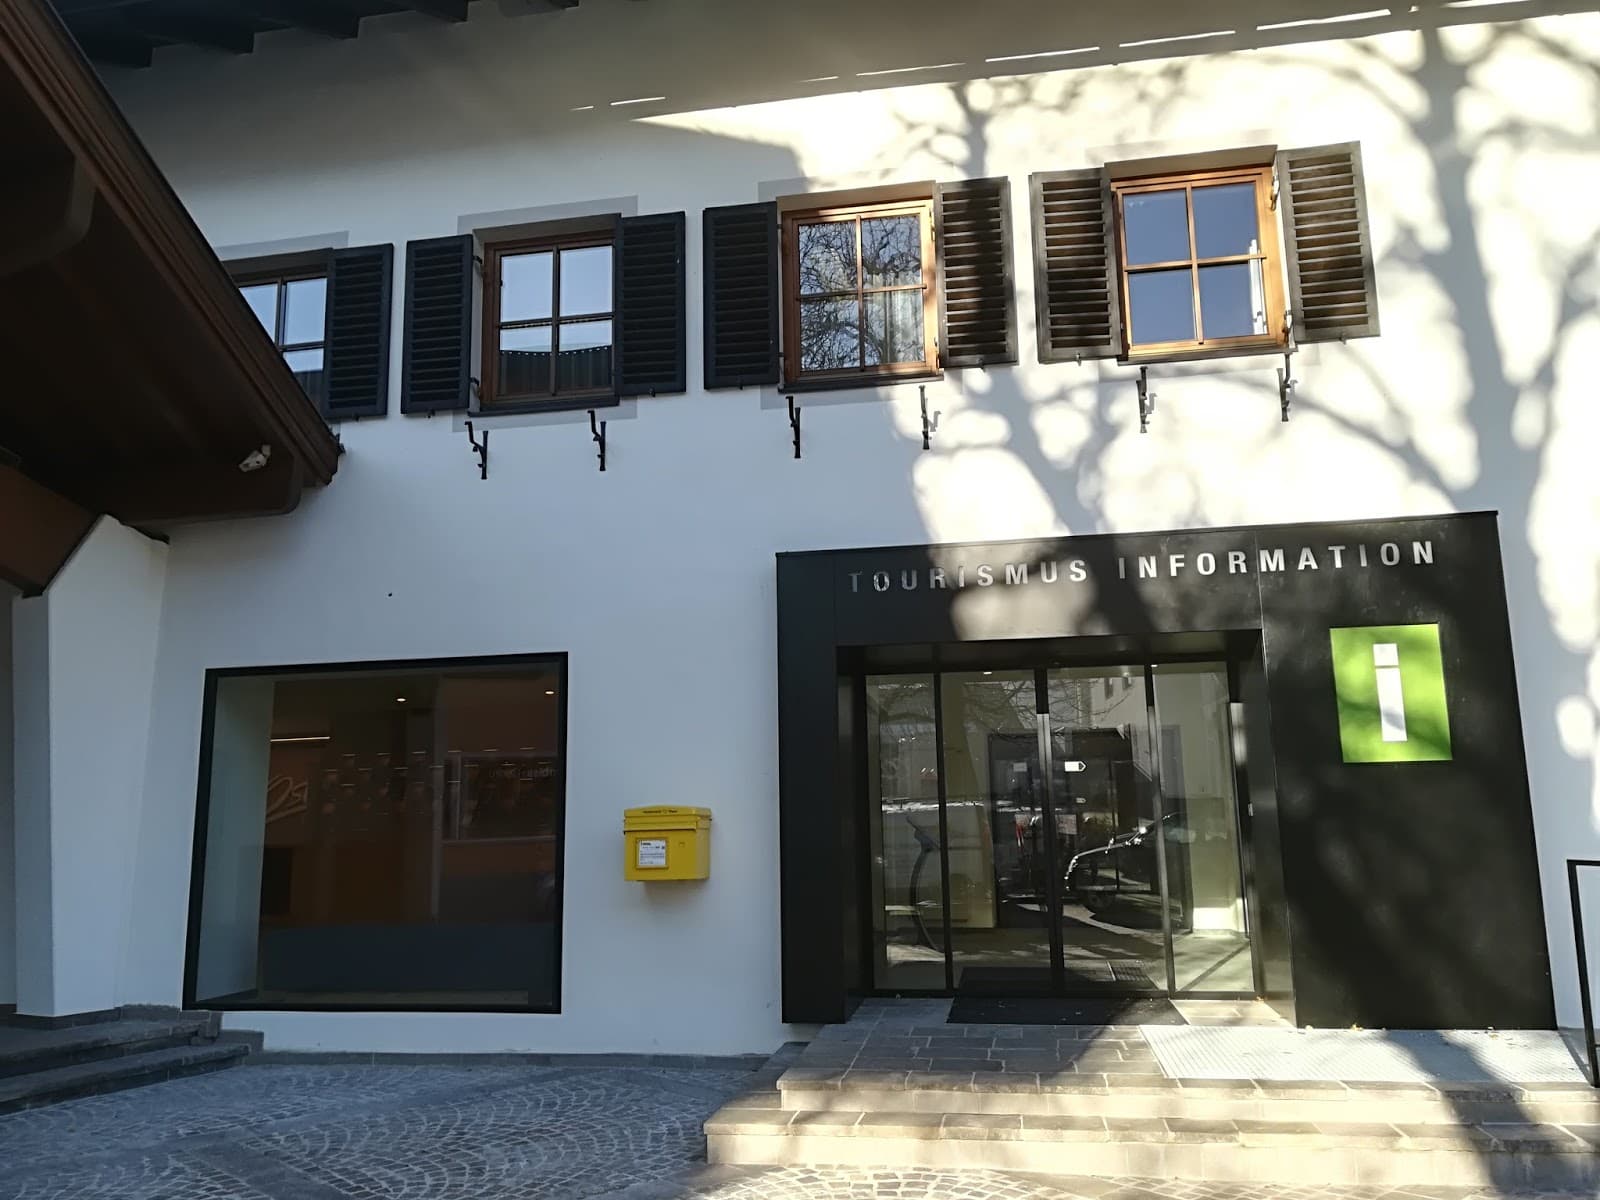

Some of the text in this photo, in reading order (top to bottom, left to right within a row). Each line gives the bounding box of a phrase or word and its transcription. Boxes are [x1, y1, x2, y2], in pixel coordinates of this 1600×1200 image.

[848, 540, 1434, 593] TOURISMUS INFORMATION
[1373, 643, 1408, 742] i
